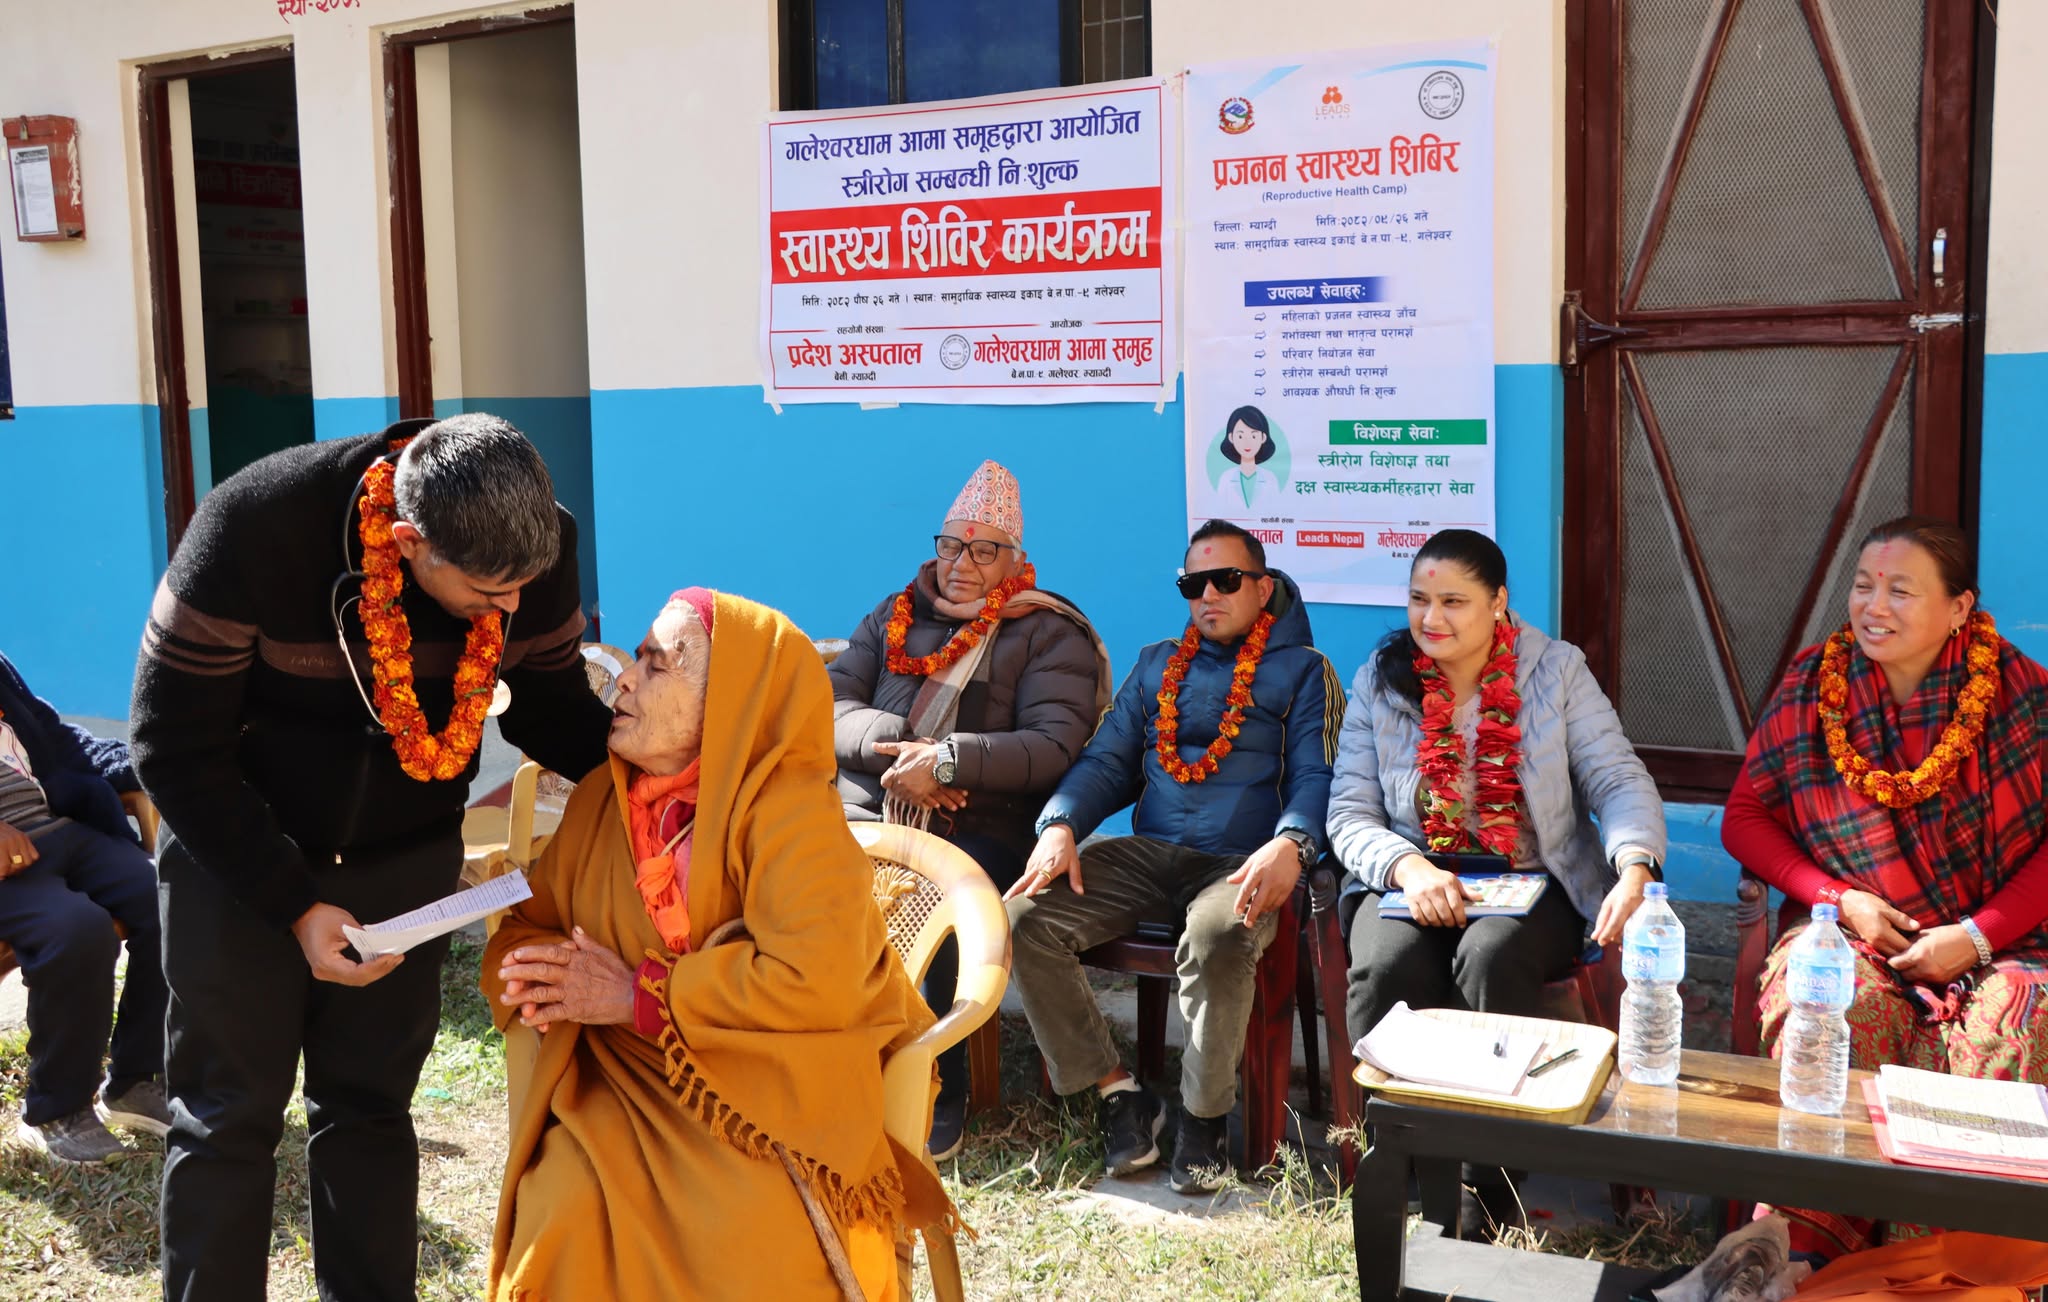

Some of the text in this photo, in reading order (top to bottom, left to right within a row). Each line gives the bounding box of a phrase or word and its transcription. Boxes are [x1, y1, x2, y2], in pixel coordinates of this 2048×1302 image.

[1315, 104, 1351, 116] LEADS
[786, 106, 1141, 161] गलेश्वरधाम आमा समूहद्वारा आयोजित
[1213, 133, 1461, 191] प्रजनन स्वास्थ्य शिबिर
[841, 167, 909, 198] स्त्रीरोग
[916, 160, 991, 193] सम्बन्धी
[1262, 184, 1407, 203] (Reproductive Health Camp)
[1414, 210, 1429, 221] गते
[1249, 218, 1277, 230] म्याग्दी
[779, 201, 1151, 278] स्वास्थ्य शिविर कार्यक्रम
[1245, 236, 1289, 252] सामुदायिक
[1294, 236, 1326, 247] स्वास्थ्य
[1417, 229, 1452, 240] गलेश्वर
[802, 294, 823, 307] मिति:
[828, 296, 849, 308] २०८२
[854, 293, 868, 304] पौष
[873, 295, 884, 306] २६
[888, 292, 900, 304] गते
[941, 289, 982, 305] सामुदायिक
[986, 288, 1016, 301] स्वास्थ्य
[1094, 284, 1126, 298] गलेश्वर
[1267, 285, 1315, 301] उपलब्ध
[1281, 310, 1320, 323] महिलाको
[1325, 310, 1352, 322] प्रजनन
[1357, 309, 1391, 320] स्वास्थ्य
[837, 324, 863, 335] सहयोगी
[1282, 328, 1321, 341] गर्भावस्था
[1326, 330, 1343, 339] तथा
[1381, 325, 1414, 339] परामर्श
[787, 338, 832, 368] प्रदेश
[838, 343, 923, 367] अस्पताल
[973, 334, 1062, 364] गलेश्वरधाम
[1067, 338, 1107, 362] आमा
[1112, 337, 1154, 367] समुह
[1282, 347, 1376, 360] परिवार नियोजन सेवा
[1282, 364, 1389, 378] स्त्रीरोग सम्बन्धी परामर्श
[1282, 386, 1320, 398] आवश्यक
[1354, 423, 1439, 441] विशेषज्ञ सेवा:
[1318, 451, 1450, 469] स्त्रीरोग विशेषज्ञ तथा
[1295, 481, 1317, 495] दक्ष
[1449, 480, 1475, 496] सेवा
[1298, 533, 1363, 546] Leads Nepal
